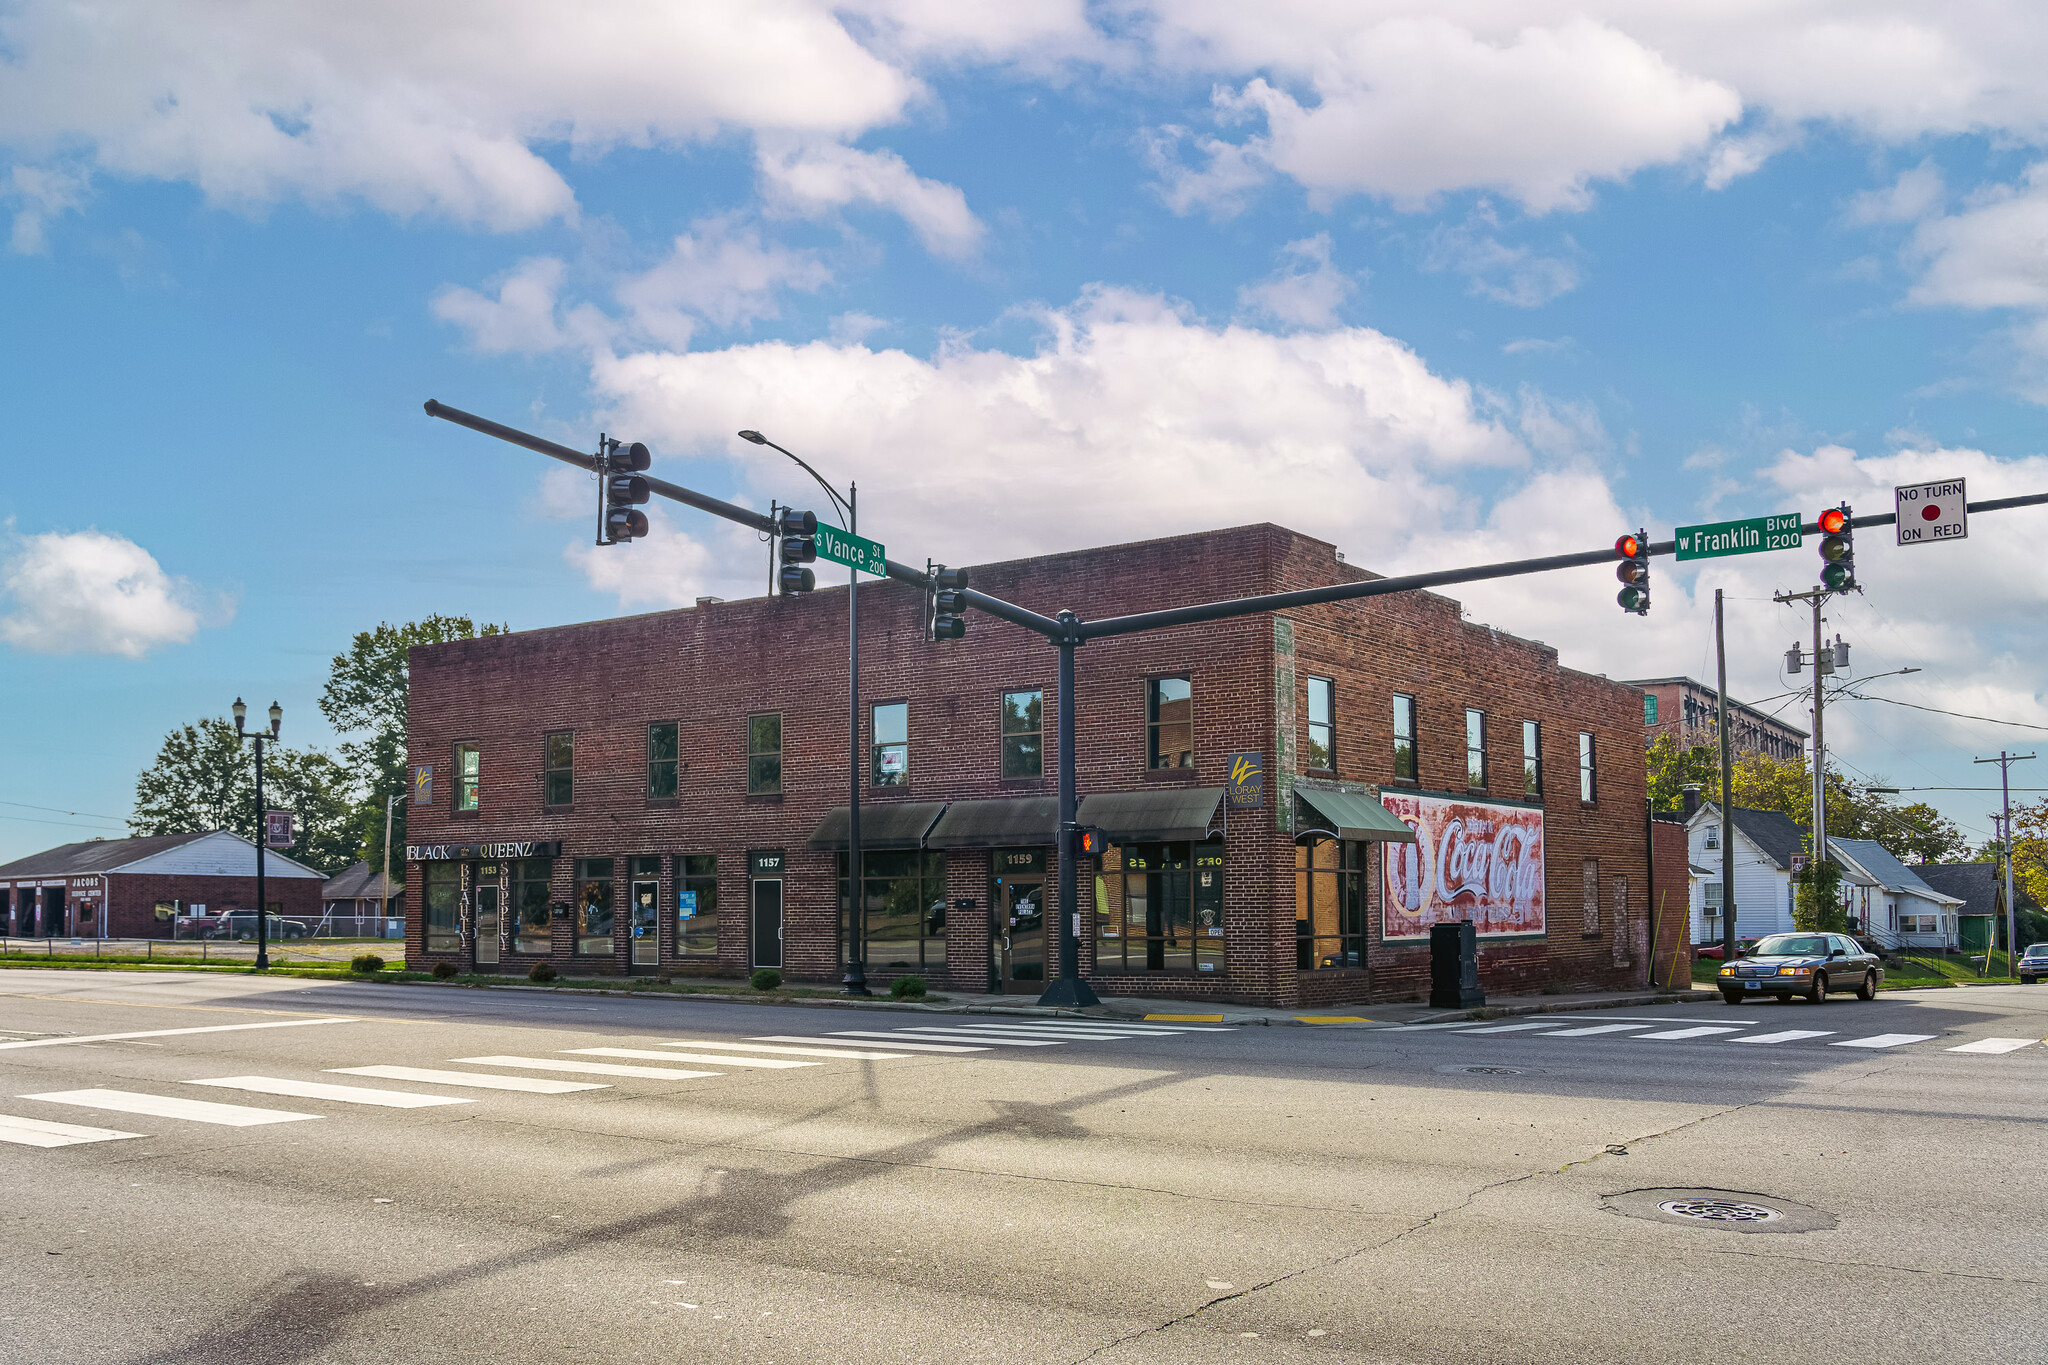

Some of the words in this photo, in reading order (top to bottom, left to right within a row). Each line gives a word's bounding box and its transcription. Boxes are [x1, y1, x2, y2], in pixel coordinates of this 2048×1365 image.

[1899, 489, 1918, 502] NO
[1924, 483, 1962, 498] TURN
[1694, 526, 1760, 553] Franklin
[1766, 515, 1797, 532] Blvd
[1766, 532, 1800, 549] 1200
[1902, 528, 1921, 541] ON
[1933, 523, 1962, 537] RED
[825, 532, 865, 565] Vance
[872, 544, 881, 558] St
[869, 560, 885, 575] 200
[1229, 784, 1262, 795] LORAY
[1231, 794, 1260, 804] WEST
[406, 845, 451, 860] BLACK
[480, 841, 533, 858] QUEENZ
[1007, 853, 1033, 865] 1159
[480, 866, 497, 875] 1153
[758, 857, 780, 867] 1157
[72, 877, 99, 888] JACOBS
[459, 863, 470, 948] BEAUTY
[500, 861, 510, 951] SUPPLY
